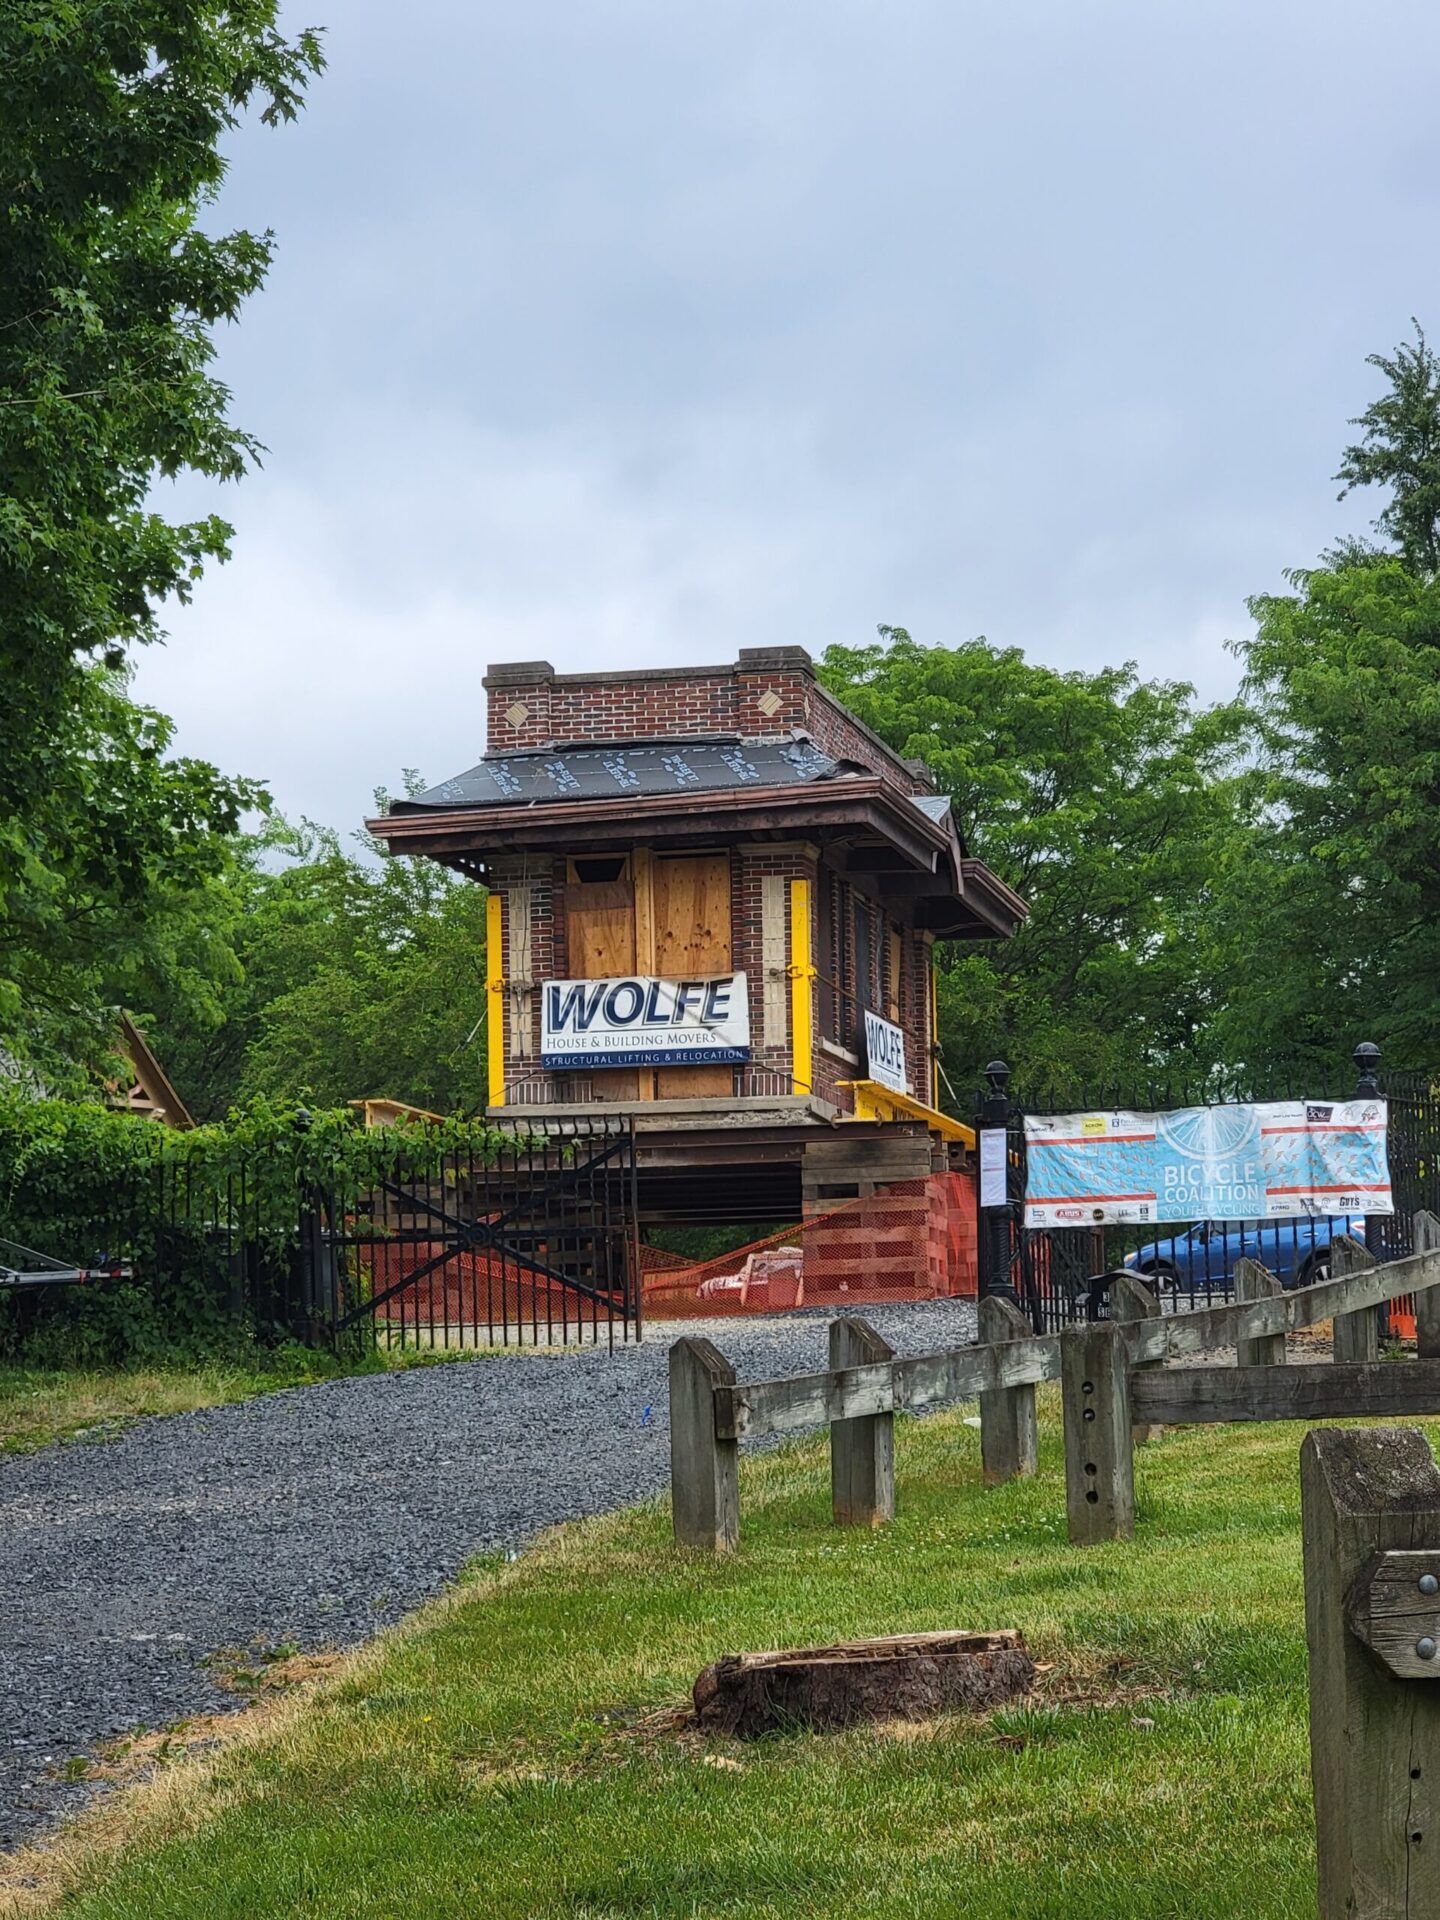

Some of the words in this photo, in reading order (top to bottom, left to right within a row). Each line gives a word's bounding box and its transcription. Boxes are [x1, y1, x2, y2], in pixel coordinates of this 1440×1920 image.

[547, 977, 733, 1034] WOLFE
[547, 1037, 587, 1048] HOUSE
[591, 1036, 601, 1047] &
[604, 1034, 663, 1047] BUILDING
[667, 1032, 717, 1045] MOVERS
[867, 1017, 901, 1071] WOLFE
[545, 1055, 613, 1066] STRUCTURAL
[618, 1052, 657, 1064] LIFTING
[664, 1052, 671, 1061] &
[676, 1050, 743, 1061] RELOCATION
[1164, 1163, 1256, 1186] BICYCLE
[1165, 1185, 1259, 1203] COALITION
[1165, 1206, 1204, 1217] YOUTH
[1207, 1203, 1260, 1217] CYCLING
